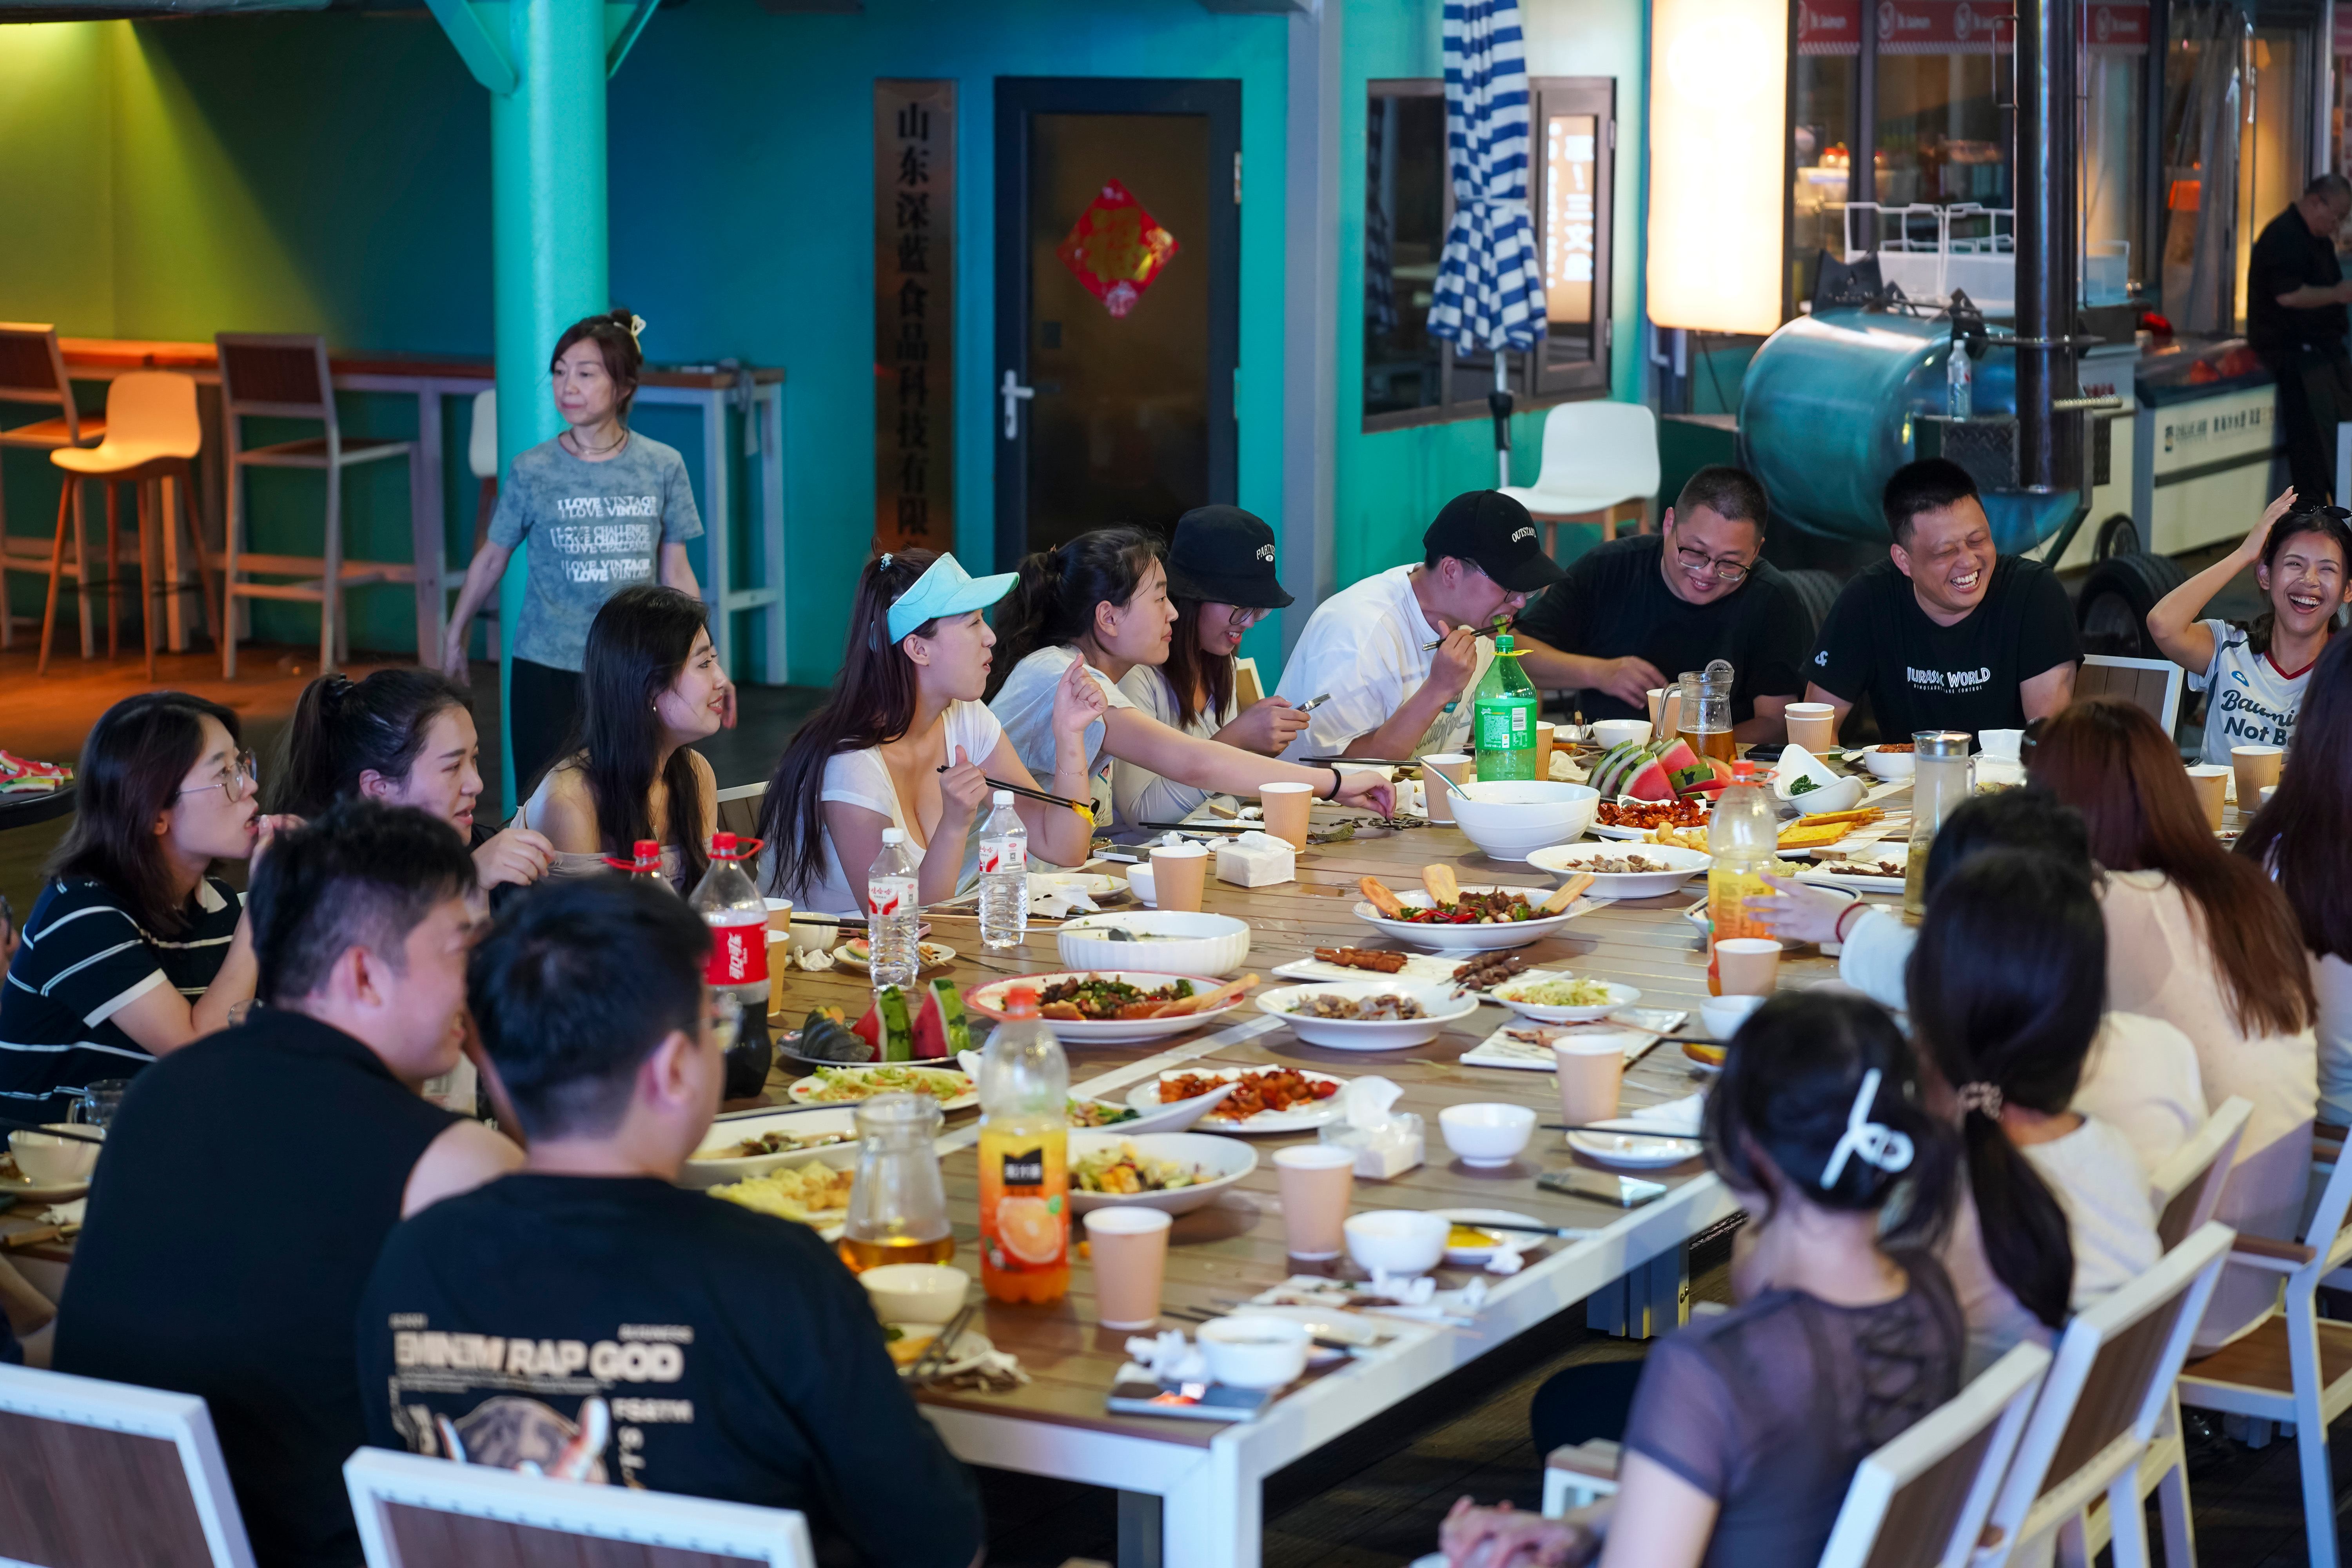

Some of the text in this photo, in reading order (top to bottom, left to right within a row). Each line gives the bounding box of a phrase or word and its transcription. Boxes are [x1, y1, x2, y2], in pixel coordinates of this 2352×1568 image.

[896, 103, 930, 550] 山东深蓝食品科技有限
[564, 497, 601, 510] LOVE
[573, 569, 608, 582] LOVE
[1947, 667, 1991, 688] WORLD
[1958, 685, 1982, 693] CONTROL
[2224, 717, 2269, 742] Not
[506, 1338, 589, 1378] RAP
[589, 1340, 685, 1384] GOD
